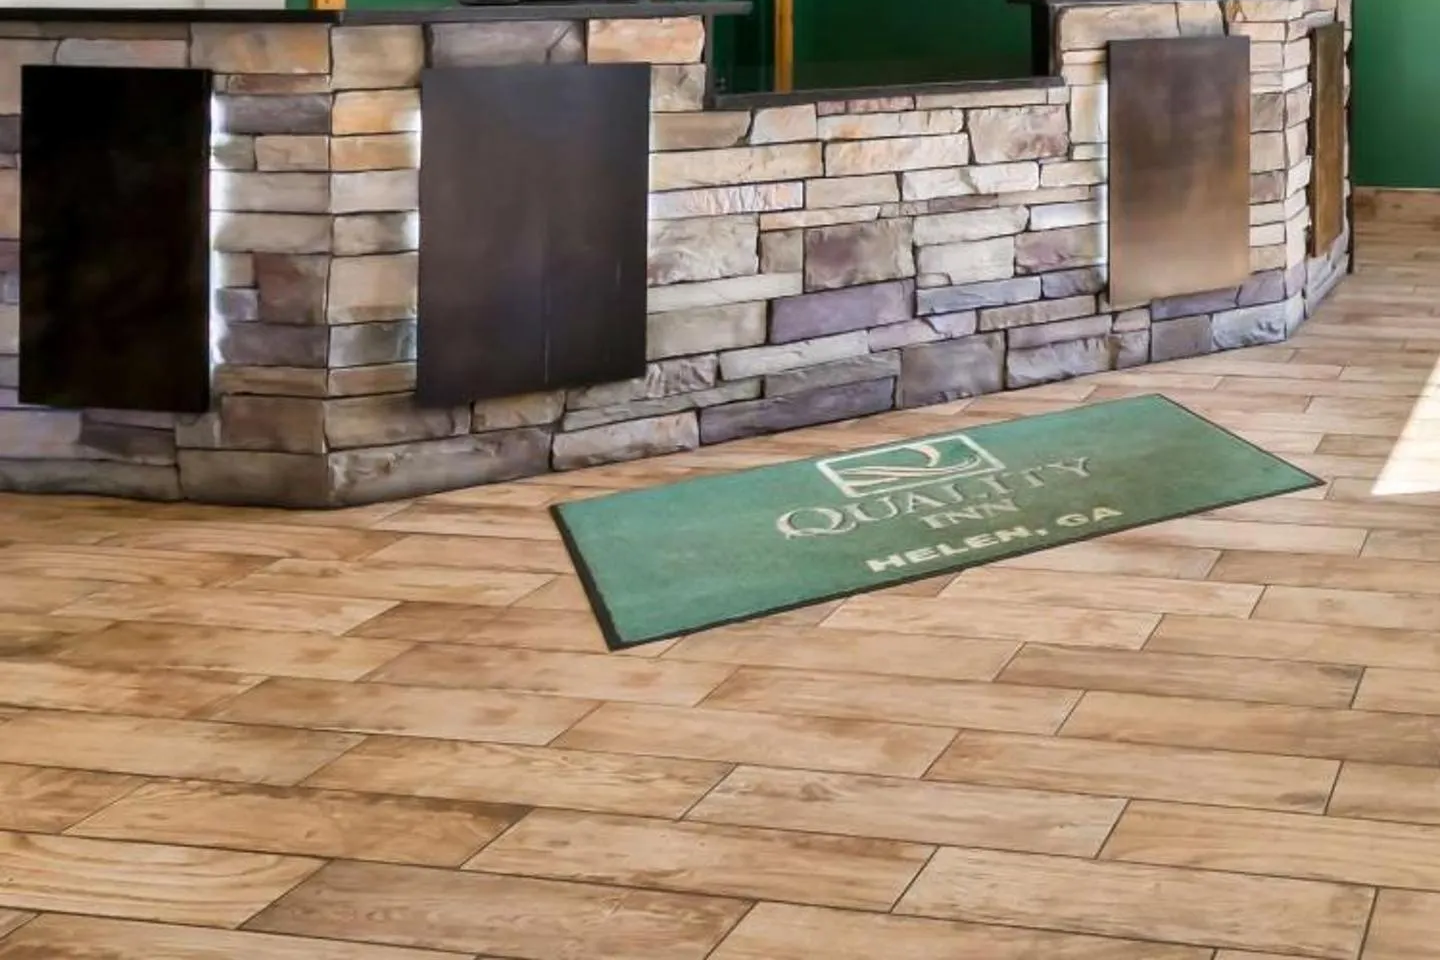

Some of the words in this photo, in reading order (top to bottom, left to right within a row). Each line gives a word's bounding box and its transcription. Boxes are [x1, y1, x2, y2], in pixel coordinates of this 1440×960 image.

[776, 456, 1093, 540] QUALITY
[921, 499, 1020, 530] INN
[1056, 506, 1123, 528] GA
